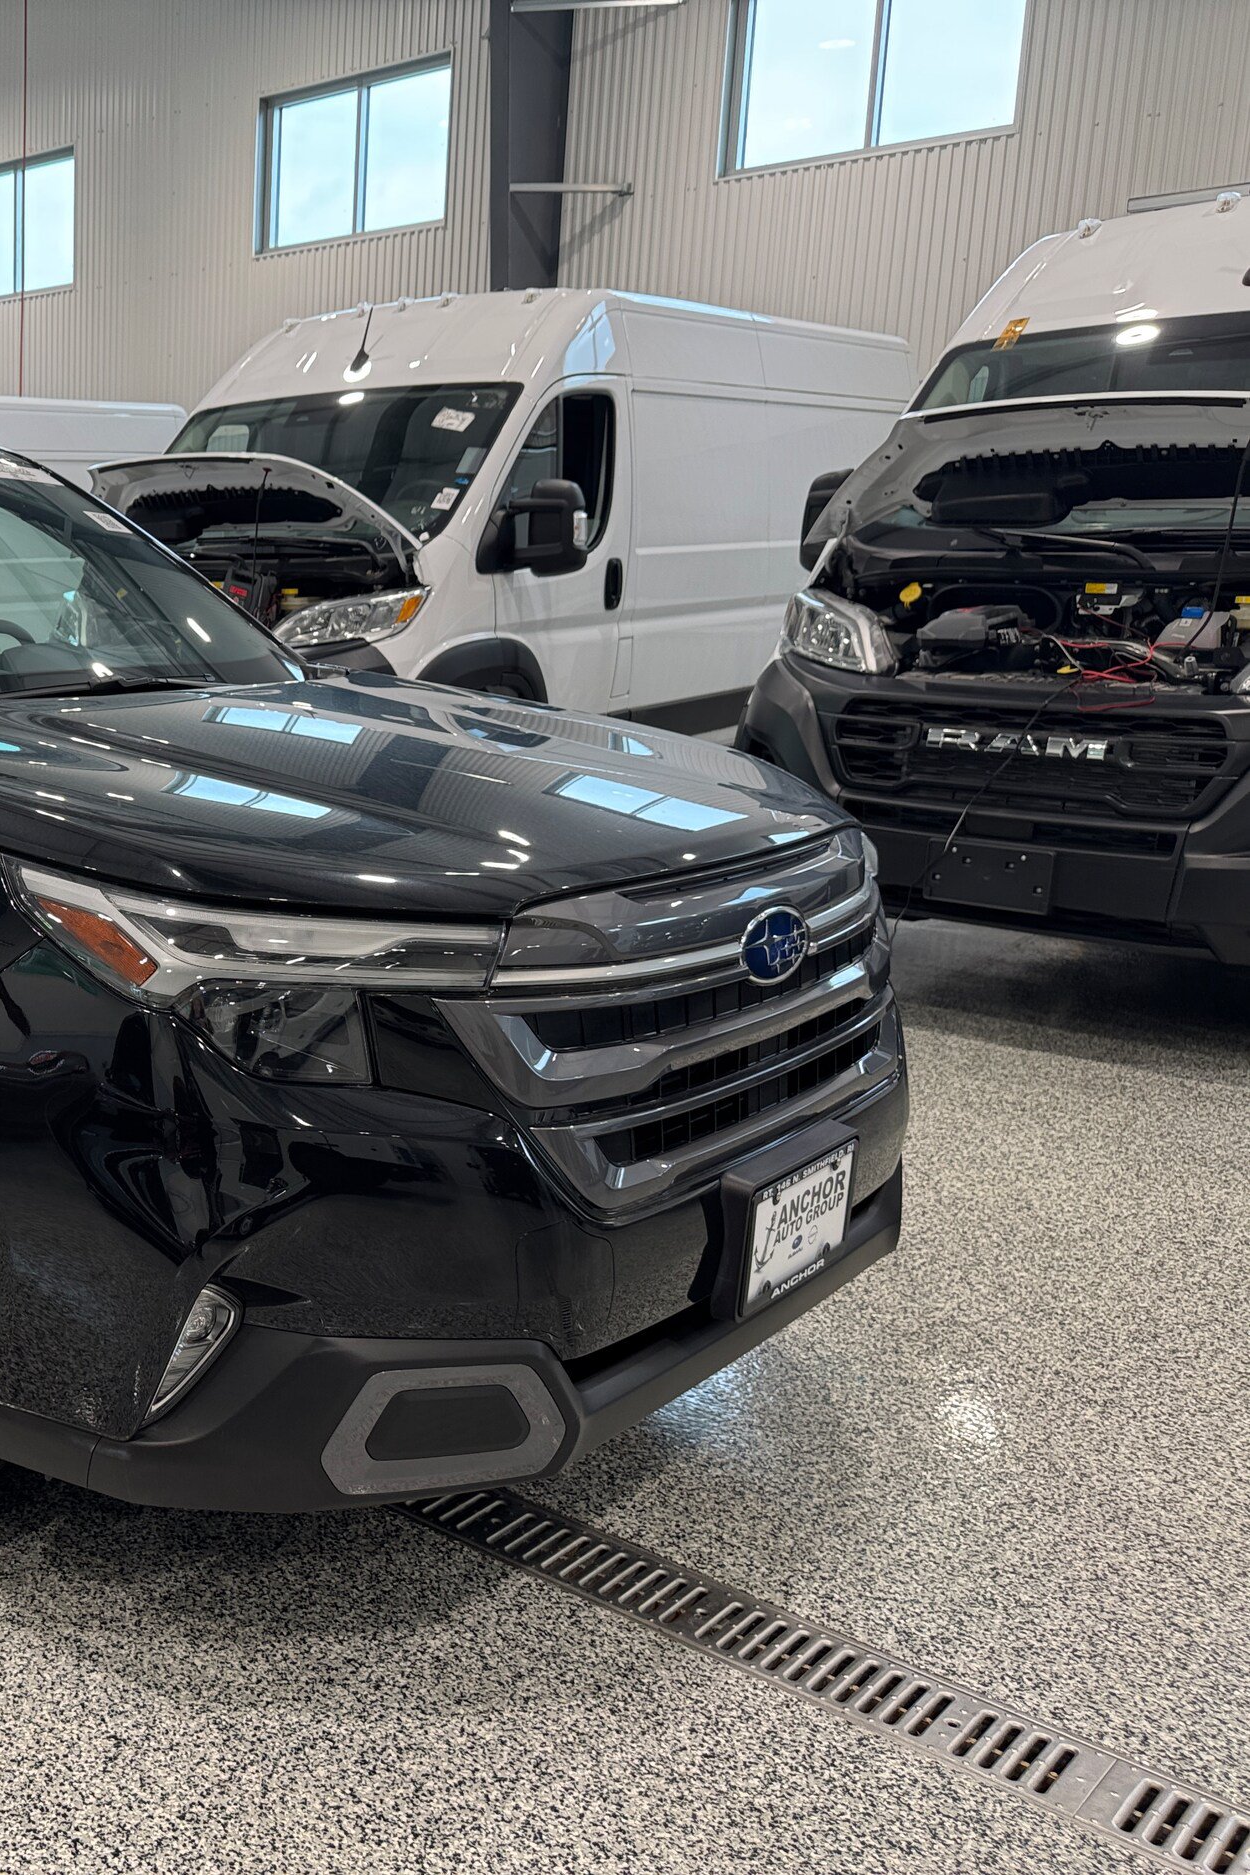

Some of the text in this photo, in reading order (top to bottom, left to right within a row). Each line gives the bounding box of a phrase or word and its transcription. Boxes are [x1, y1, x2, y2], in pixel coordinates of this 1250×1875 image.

[925, 727, 1109, 762] RAM
[773, 1191, 844, 1246] AUTO GROUP
[777, 1169, 846, 1230] ANCHOR
[771, 1258, 825, 1299] ANCHOR
